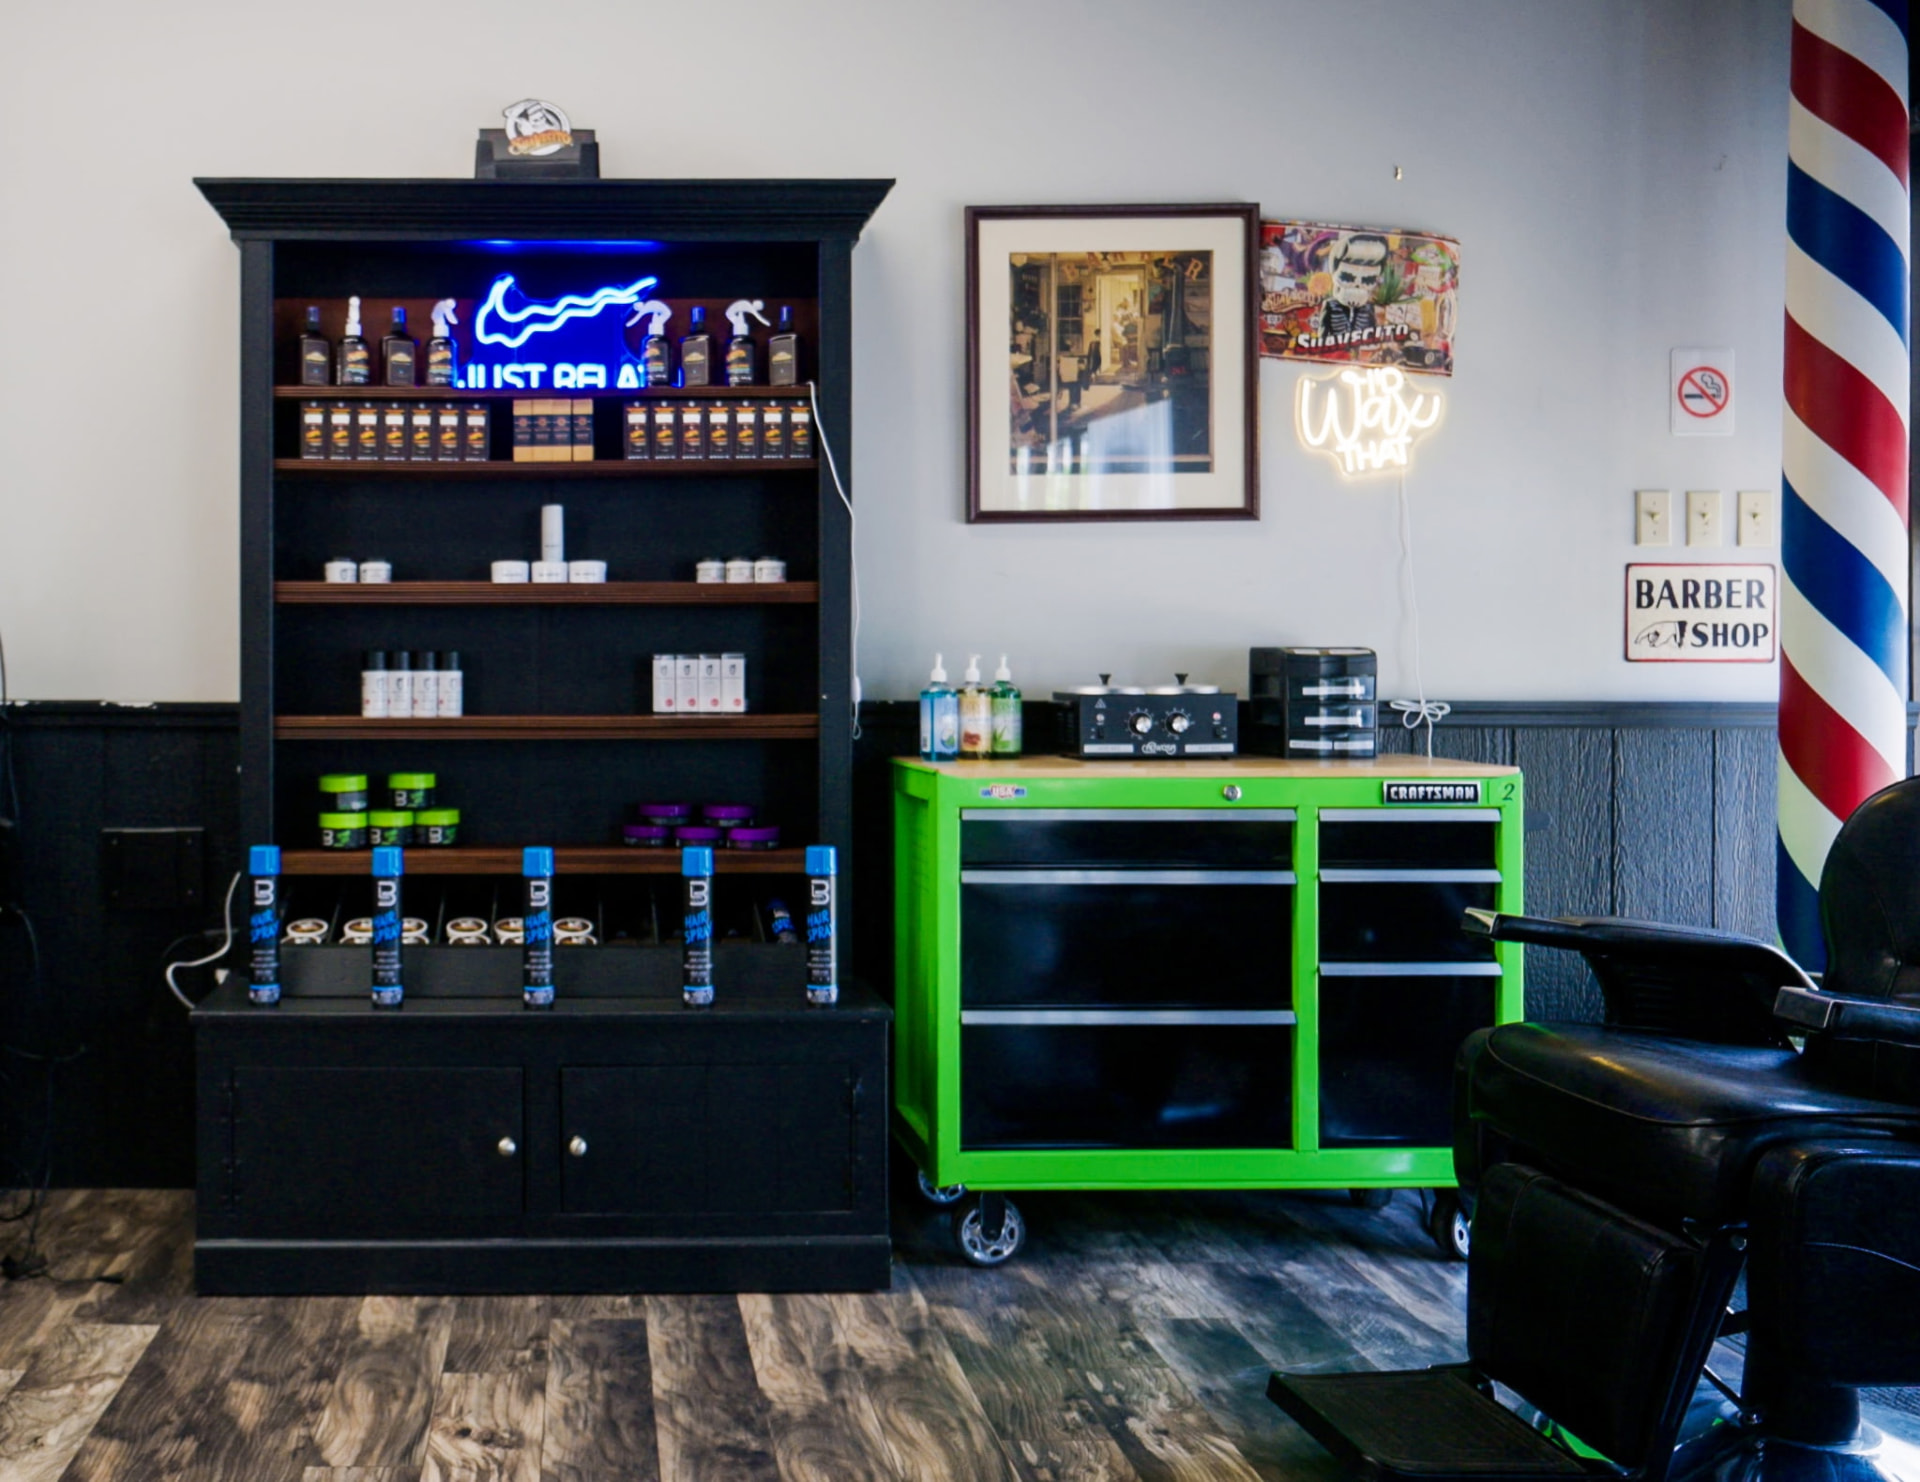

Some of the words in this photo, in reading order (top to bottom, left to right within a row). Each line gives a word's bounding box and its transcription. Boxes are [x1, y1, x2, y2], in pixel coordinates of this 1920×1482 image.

[1295, 324, 1409, 354] SUAVECITO
[1336, 437, 1412, 472] THAT
[1636, 579, 1766, 609] BARBER
[1691, 622, 1768, 648] SHOP
[1390, 786, 1475, 800] CRAFTSMAN
[1502, 783, 1515, 801] 2
[526, 910, 548, 928] HAIR
[685, 910, 707, 928] HAIR
[807, 909, 829, 926] HAIR
[685, 920, 713, 944] SPRAY
